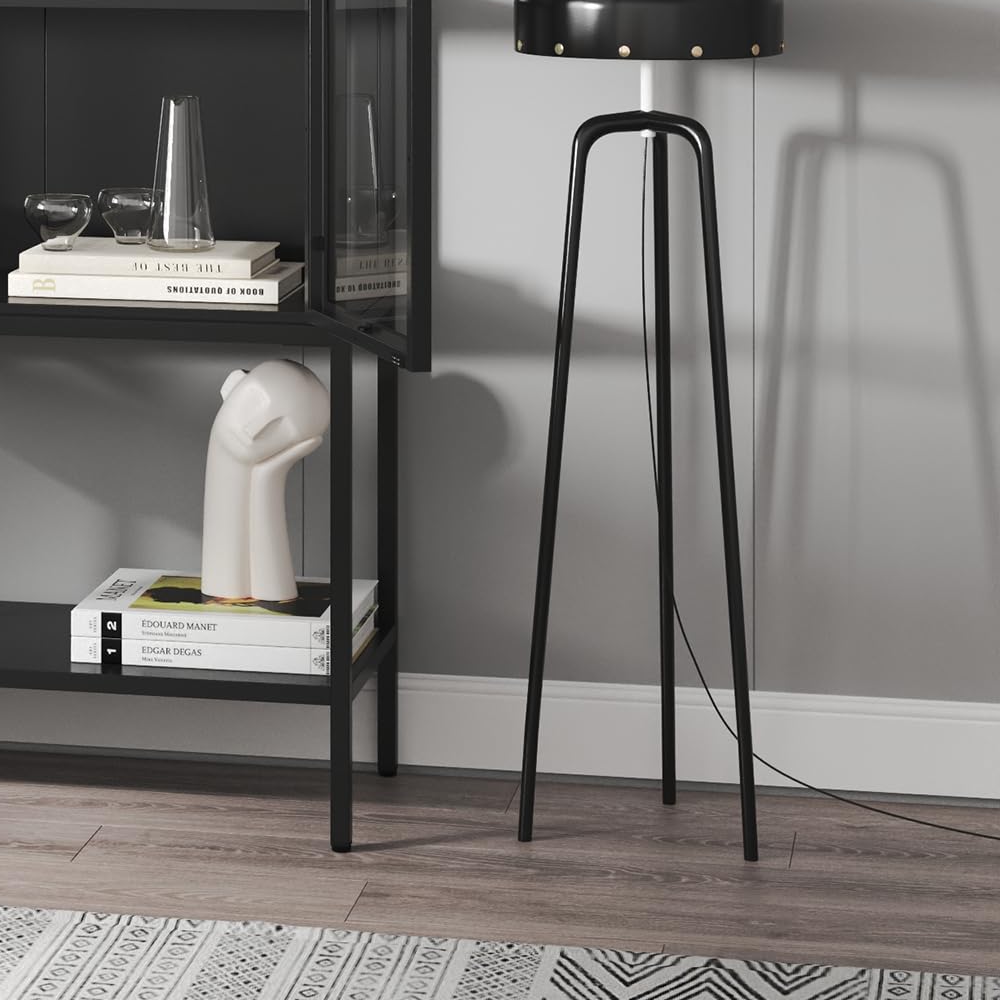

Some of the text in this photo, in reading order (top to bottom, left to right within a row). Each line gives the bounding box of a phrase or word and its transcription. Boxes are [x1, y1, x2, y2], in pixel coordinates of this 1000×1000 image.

[154, 263, 189, 272] BEST
[196, 263, 222, 273] THE
[167, 286, 264, 296] BOOK OF QUOTATIONS
[96, 579, 136, 600] MANET
[107, 621, 117, 631] 2
[142, 619, 217, 631] ÉDOUARD MANET
[142, 647, 202, 656] EDGAR DEGAS
